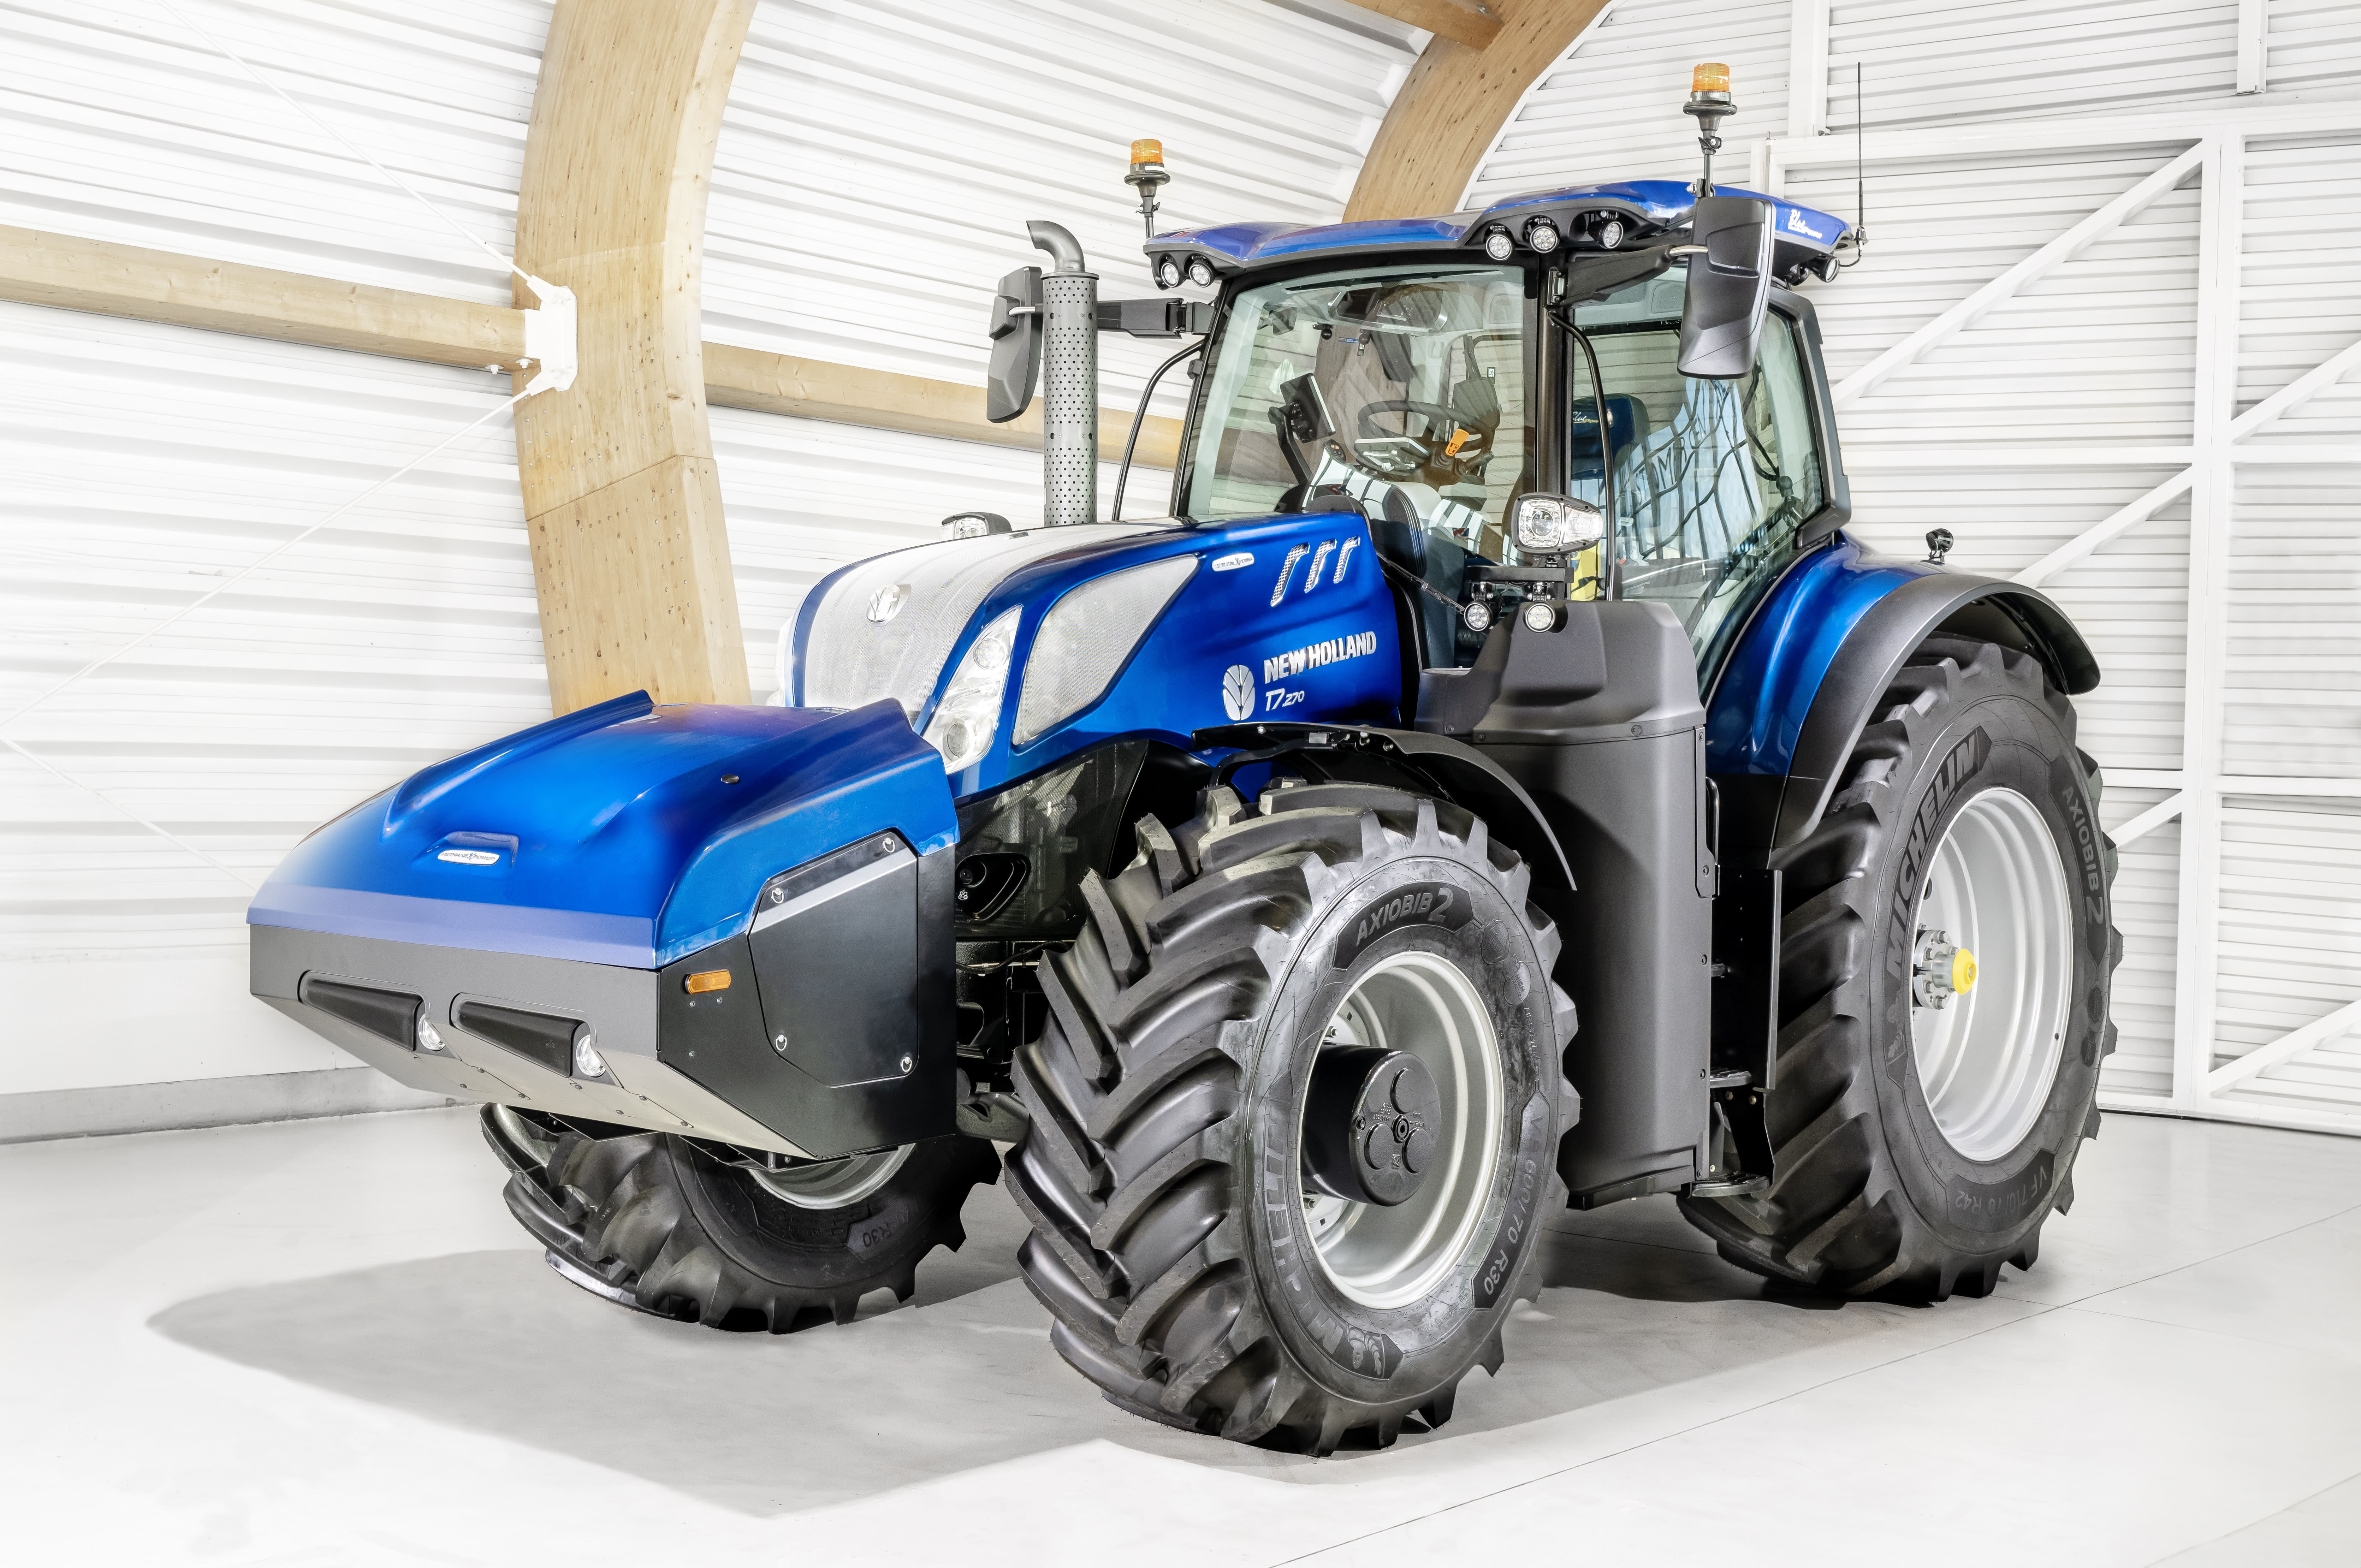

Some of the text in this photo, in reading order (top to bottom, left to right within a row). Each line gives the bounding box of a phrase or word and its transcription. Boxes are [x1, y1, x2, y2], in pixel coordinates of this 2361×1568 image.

[1264, 631, 1376, 684] NEW HOLLAND
[1886, 733, 1977, 981] MICHELIN
[2062, 786, 2104, 925] AXIOBIB 2
[1356, 892, 1435, 947] AXIOBIB
[1427, 887, 1454, 923] 2
[1508, 1160, 1536, 1244] 600/70
[1955, 1189, 1982, 1215] R42
[2031, 1165, 2047, 1198] VF
[1264, 1124, 1344, 1355] MICHELIN
[1484, 1249, 1508, 1295] R30
